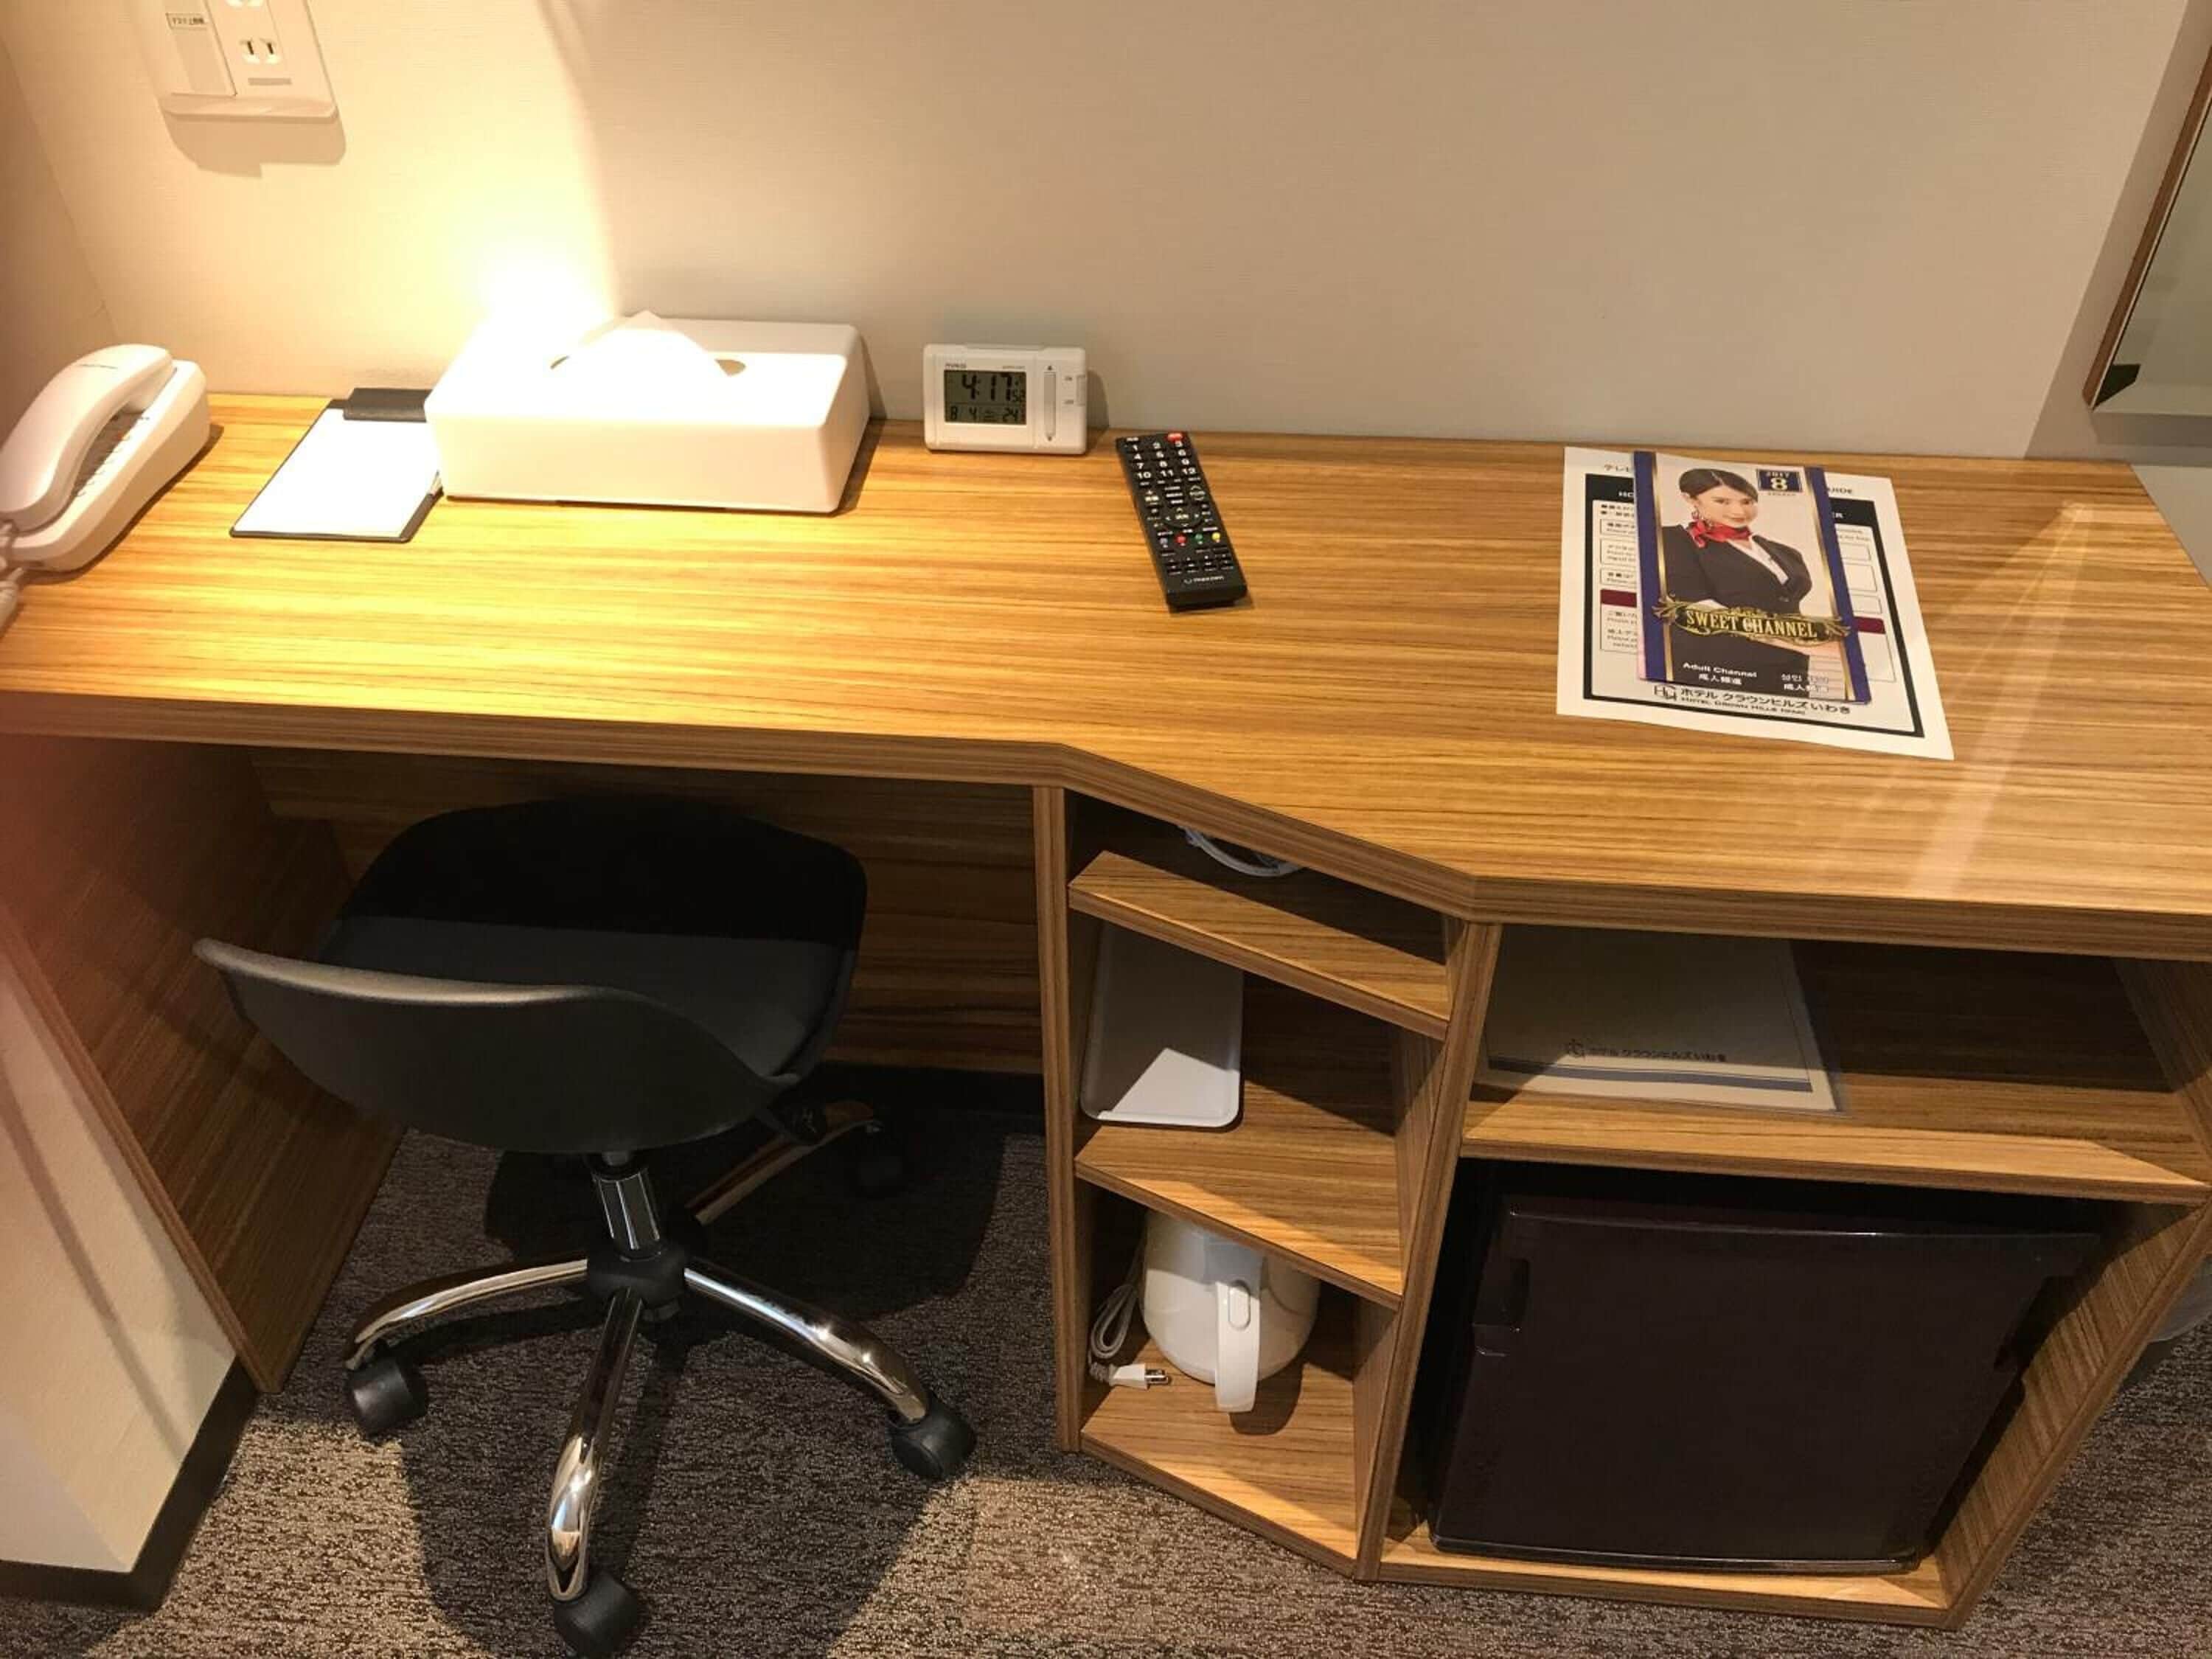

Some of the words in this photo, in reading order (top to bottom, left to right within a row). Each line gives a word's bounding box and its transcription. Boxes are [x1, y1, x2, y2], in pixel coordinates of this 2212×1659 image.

[961, 372, 1012, 401] 4:17
[1770, 477, 1788, 490] 8
[1686, 610, 1739, 632] SWEET
[1742, 617, 1818, 639] CHANNEL
[1683, 662, 1711, 672] Adult
[1714, 667, 1758, 678] Channel
[1681, 688, 1718, 700] ホテル
[1722, 693, 1809, 709] クラウンヒルズ
